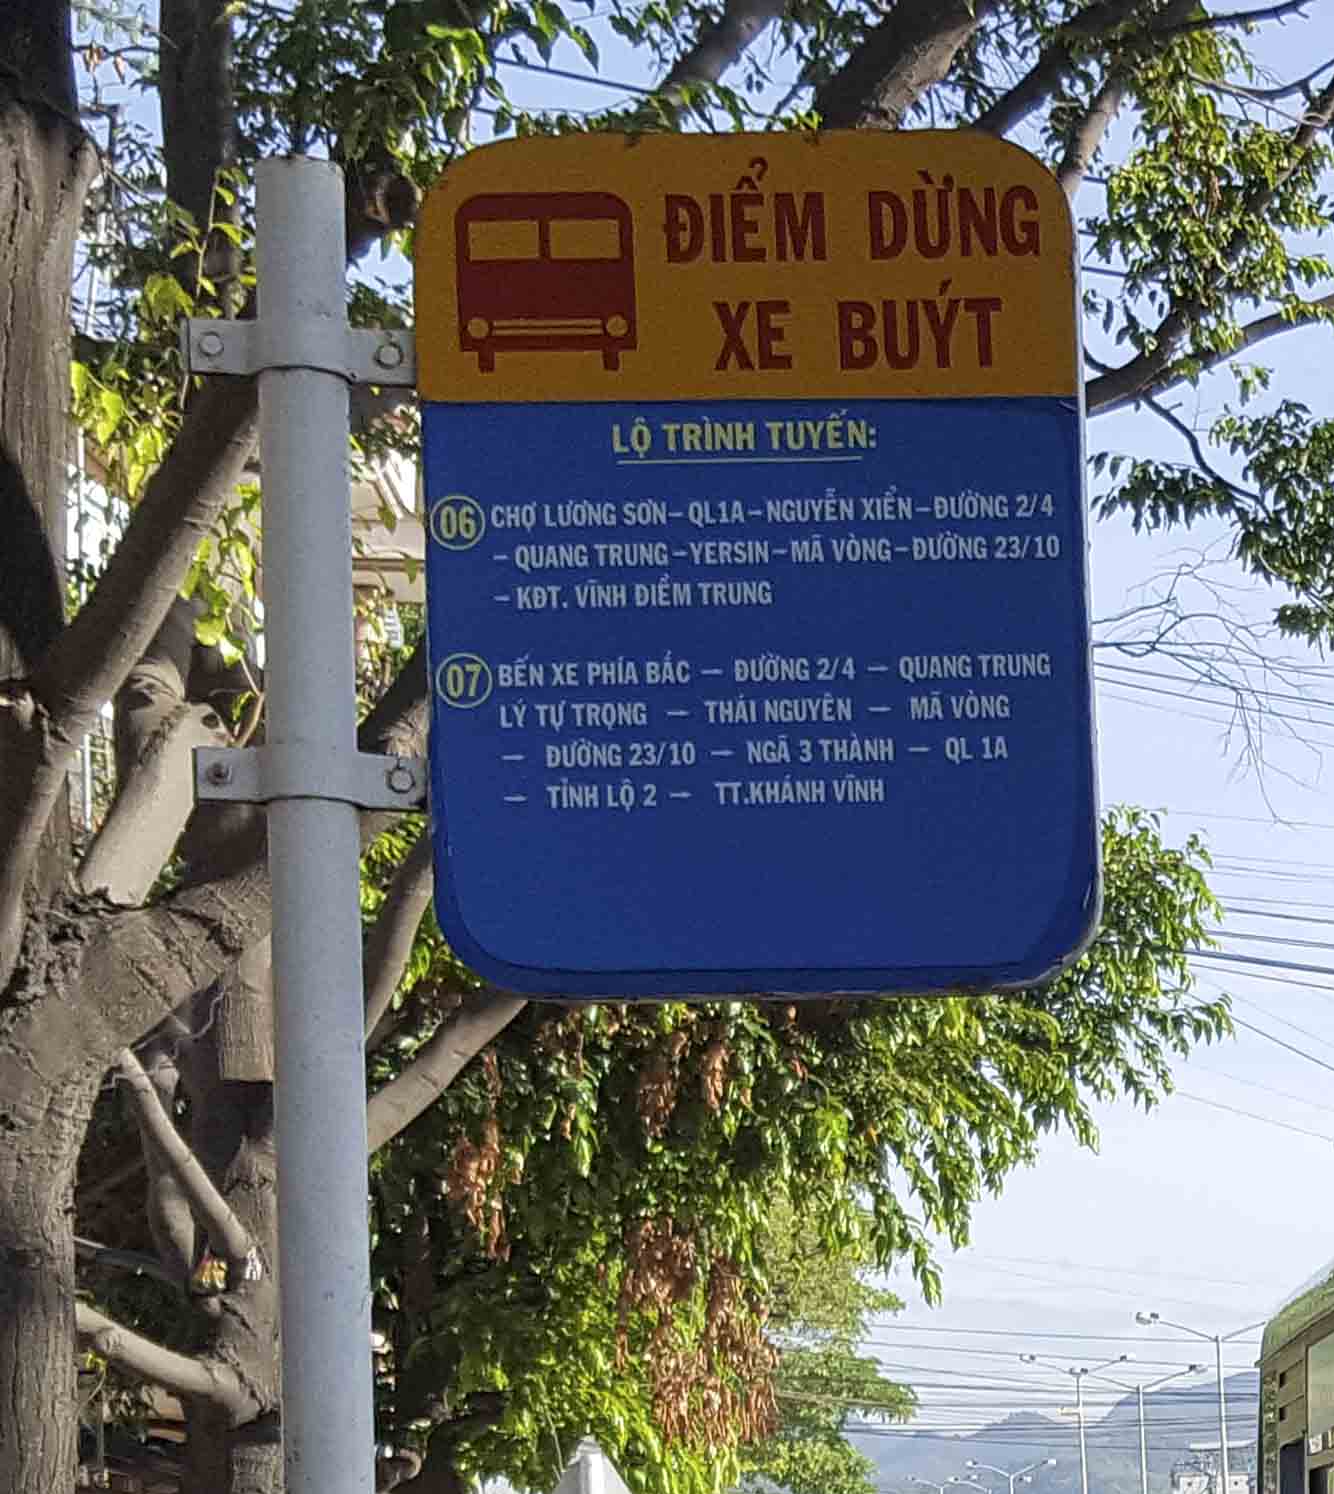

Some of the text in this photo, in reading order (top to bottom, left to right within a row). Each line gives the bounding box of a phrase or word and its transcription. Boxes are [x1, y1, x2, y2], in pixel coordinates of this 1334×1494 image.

[663, 157, 1041, 263] ĐIỂM DỪNG
[714, 279, 1005, 371] XE BUÝT
[612, 408, 877, 458] LỘ TRÌNH TUYẾN:
[440, 505, 476, 539] 06
[491, 502, 537, 533] CHỢ
[544, 500, 617, 527] LƯƠNG
[688, 500, 745, 528] QL1A
[767, 487, 855, 523] NGUYỄN
[1015, 494, 1054, 518] 2/4
[514, 543, 589, 574] QUANG
[594, 542, 669, 567] TRUNG
[689, 538, 769, 565] YERSIN
[791, 533, 825, 563] MÃ
[831, 532, 892, 563] VÒNG
[994, 535, 1060, 559] 23/10
[517, 585, 568, 610] KĐT.
[575, 578, 626, 608] VĨNH
[698, 580, 773, 606] TRUNG
[446, 663, 482, 698] 07
[499, 652, 544, 688] BẾN
[552, 663, 579, 686] XE
[588, 657, 639, 685] PHÍA
[645, 650, 691, 684] BẮC
[734, 653, 810, 682] ĐƯỜNG
[817, 658, 856, 681] 2/4
[899, 655, 973, 683] QUANG
[977, 653, 1051, 677] TRUNG
[500, 699, 526, 728] LÝ
[534, 701, 566, 733] TỰ
[571, 701, 648, 732] TRỌNG
[704, 693, 757, 723] THÁI
[764, 692, 852, 722] NGUYÊN
[910, 690, 944, 720] MÃ
[950, 689, 1010, 720] VÒNG
[546, 738, 622, 768] ĐƯỜNG
[629, 741, 695, 767] 23/10
[747, 734, 791, 764] NGÃ
[800, 738, 813, 763] 3
[819, 732, 895, 763] THÀNH
[944, 736, 973, 765] QL
[981, 735, 1009, 760] 1A
[546, 777, 599, 809] TỈNH
[607, 778, 635, 813] LỘ
[643, 784, 657, 807] 2
[833, 774, 885, 803] VĨNH
